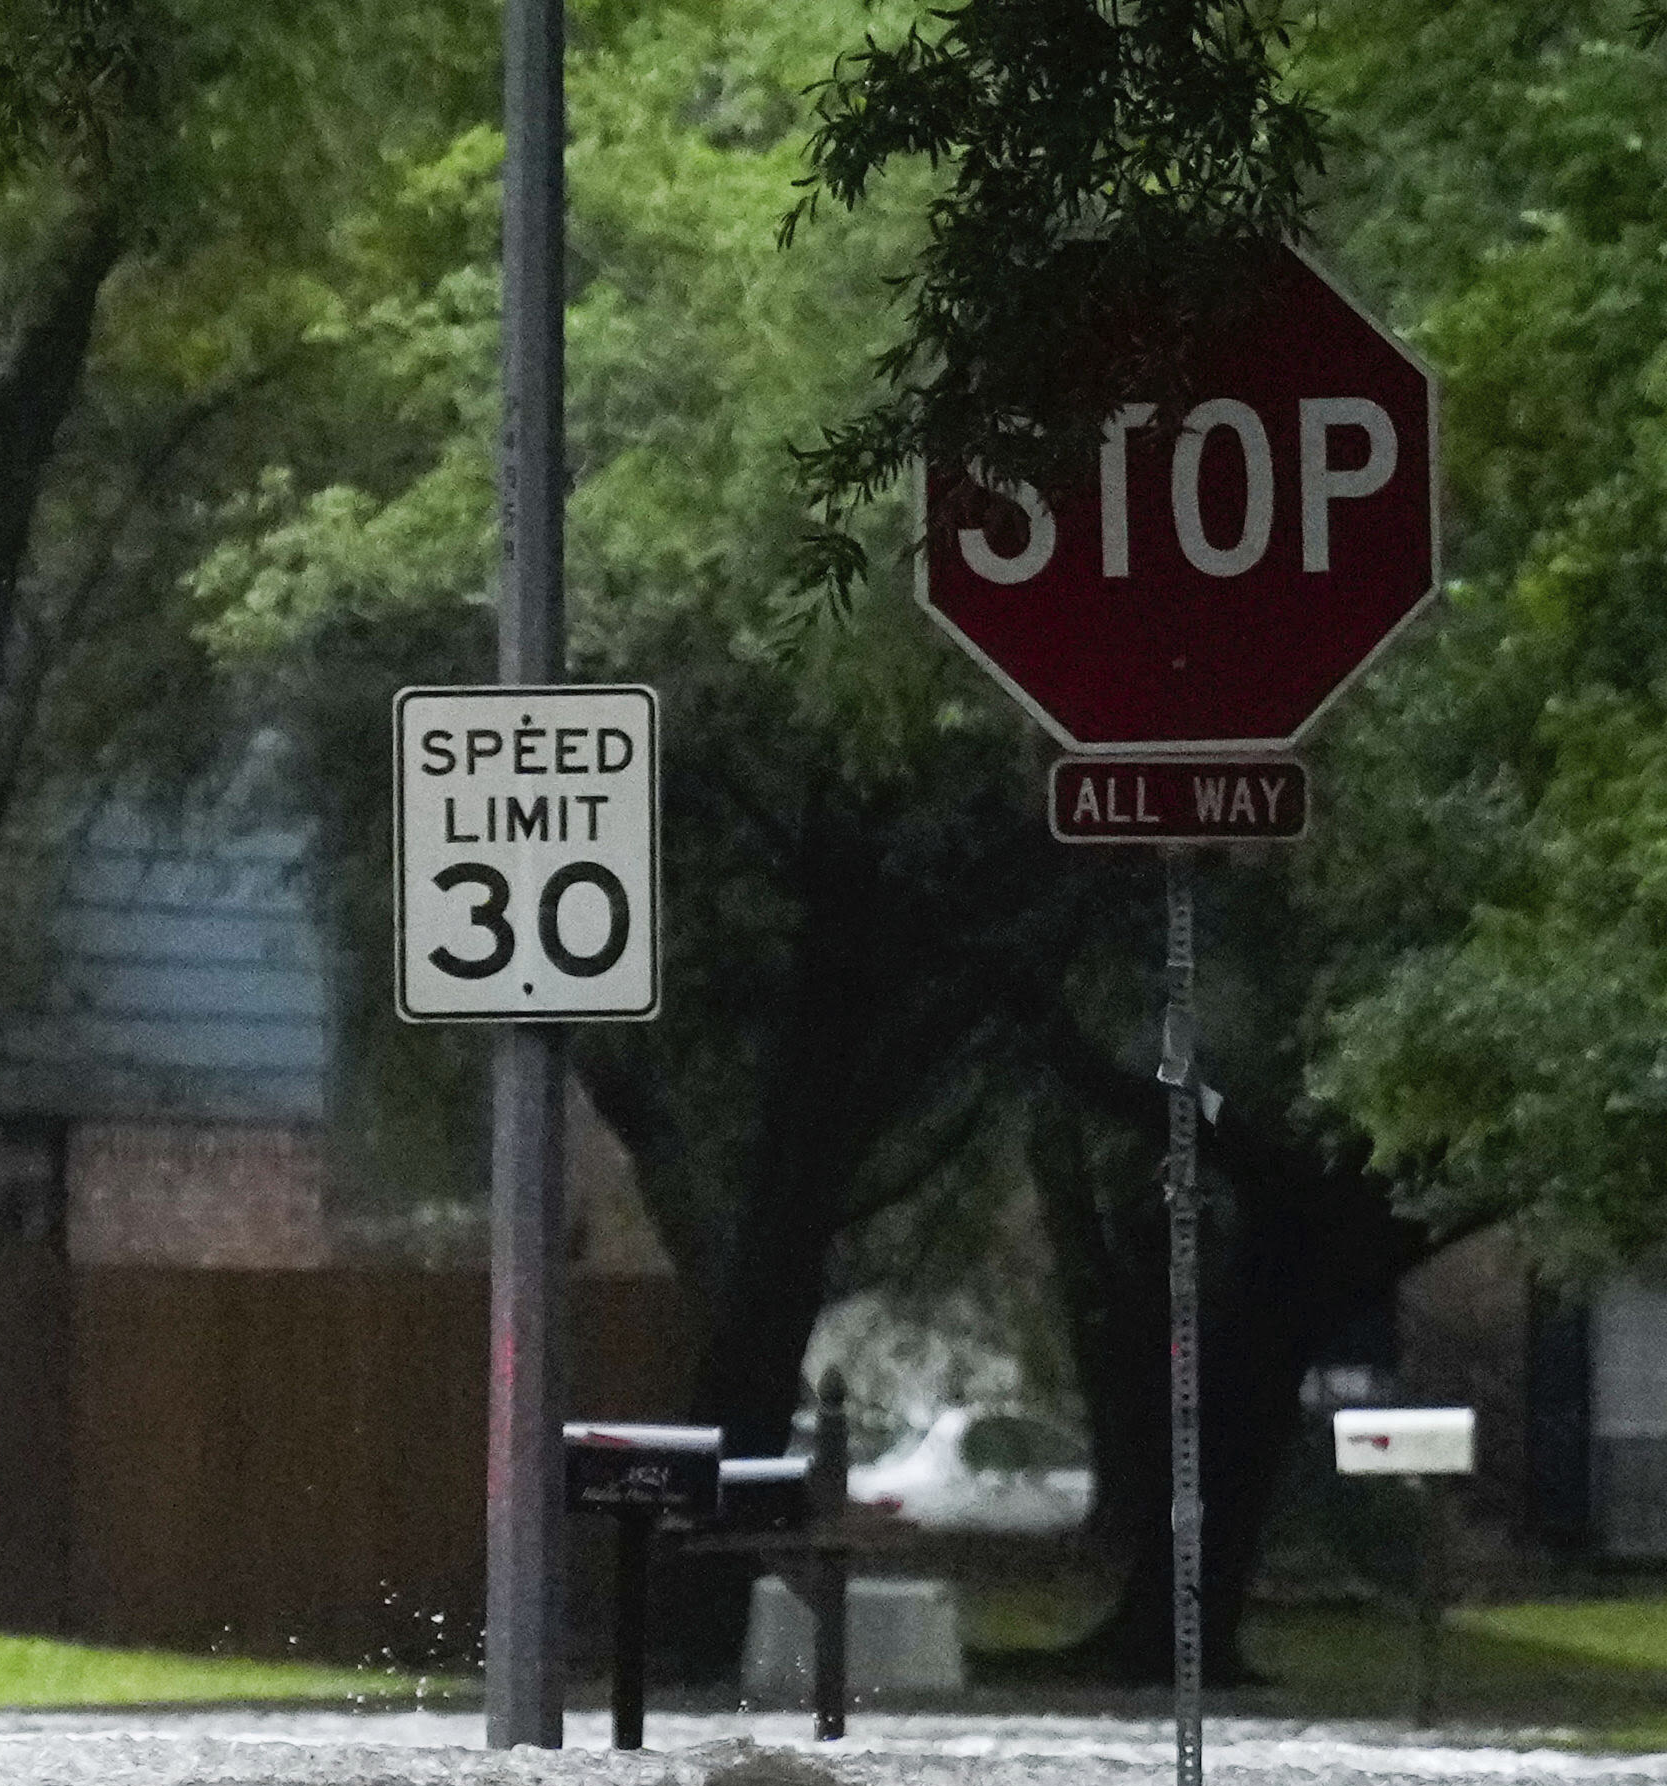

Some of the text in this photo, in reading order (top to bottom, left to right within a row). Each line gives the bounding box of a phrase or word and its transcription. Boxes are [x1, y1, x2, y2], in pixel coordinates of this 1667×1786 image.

[958, 397, 1399, 585] STOP
[421, 727, 634, 776] SPEED
[445, 795, 609, 843] LIMIT
[1072, 776, 1286, 823] ALL WAY
[427, 861, 631, 980] 30
